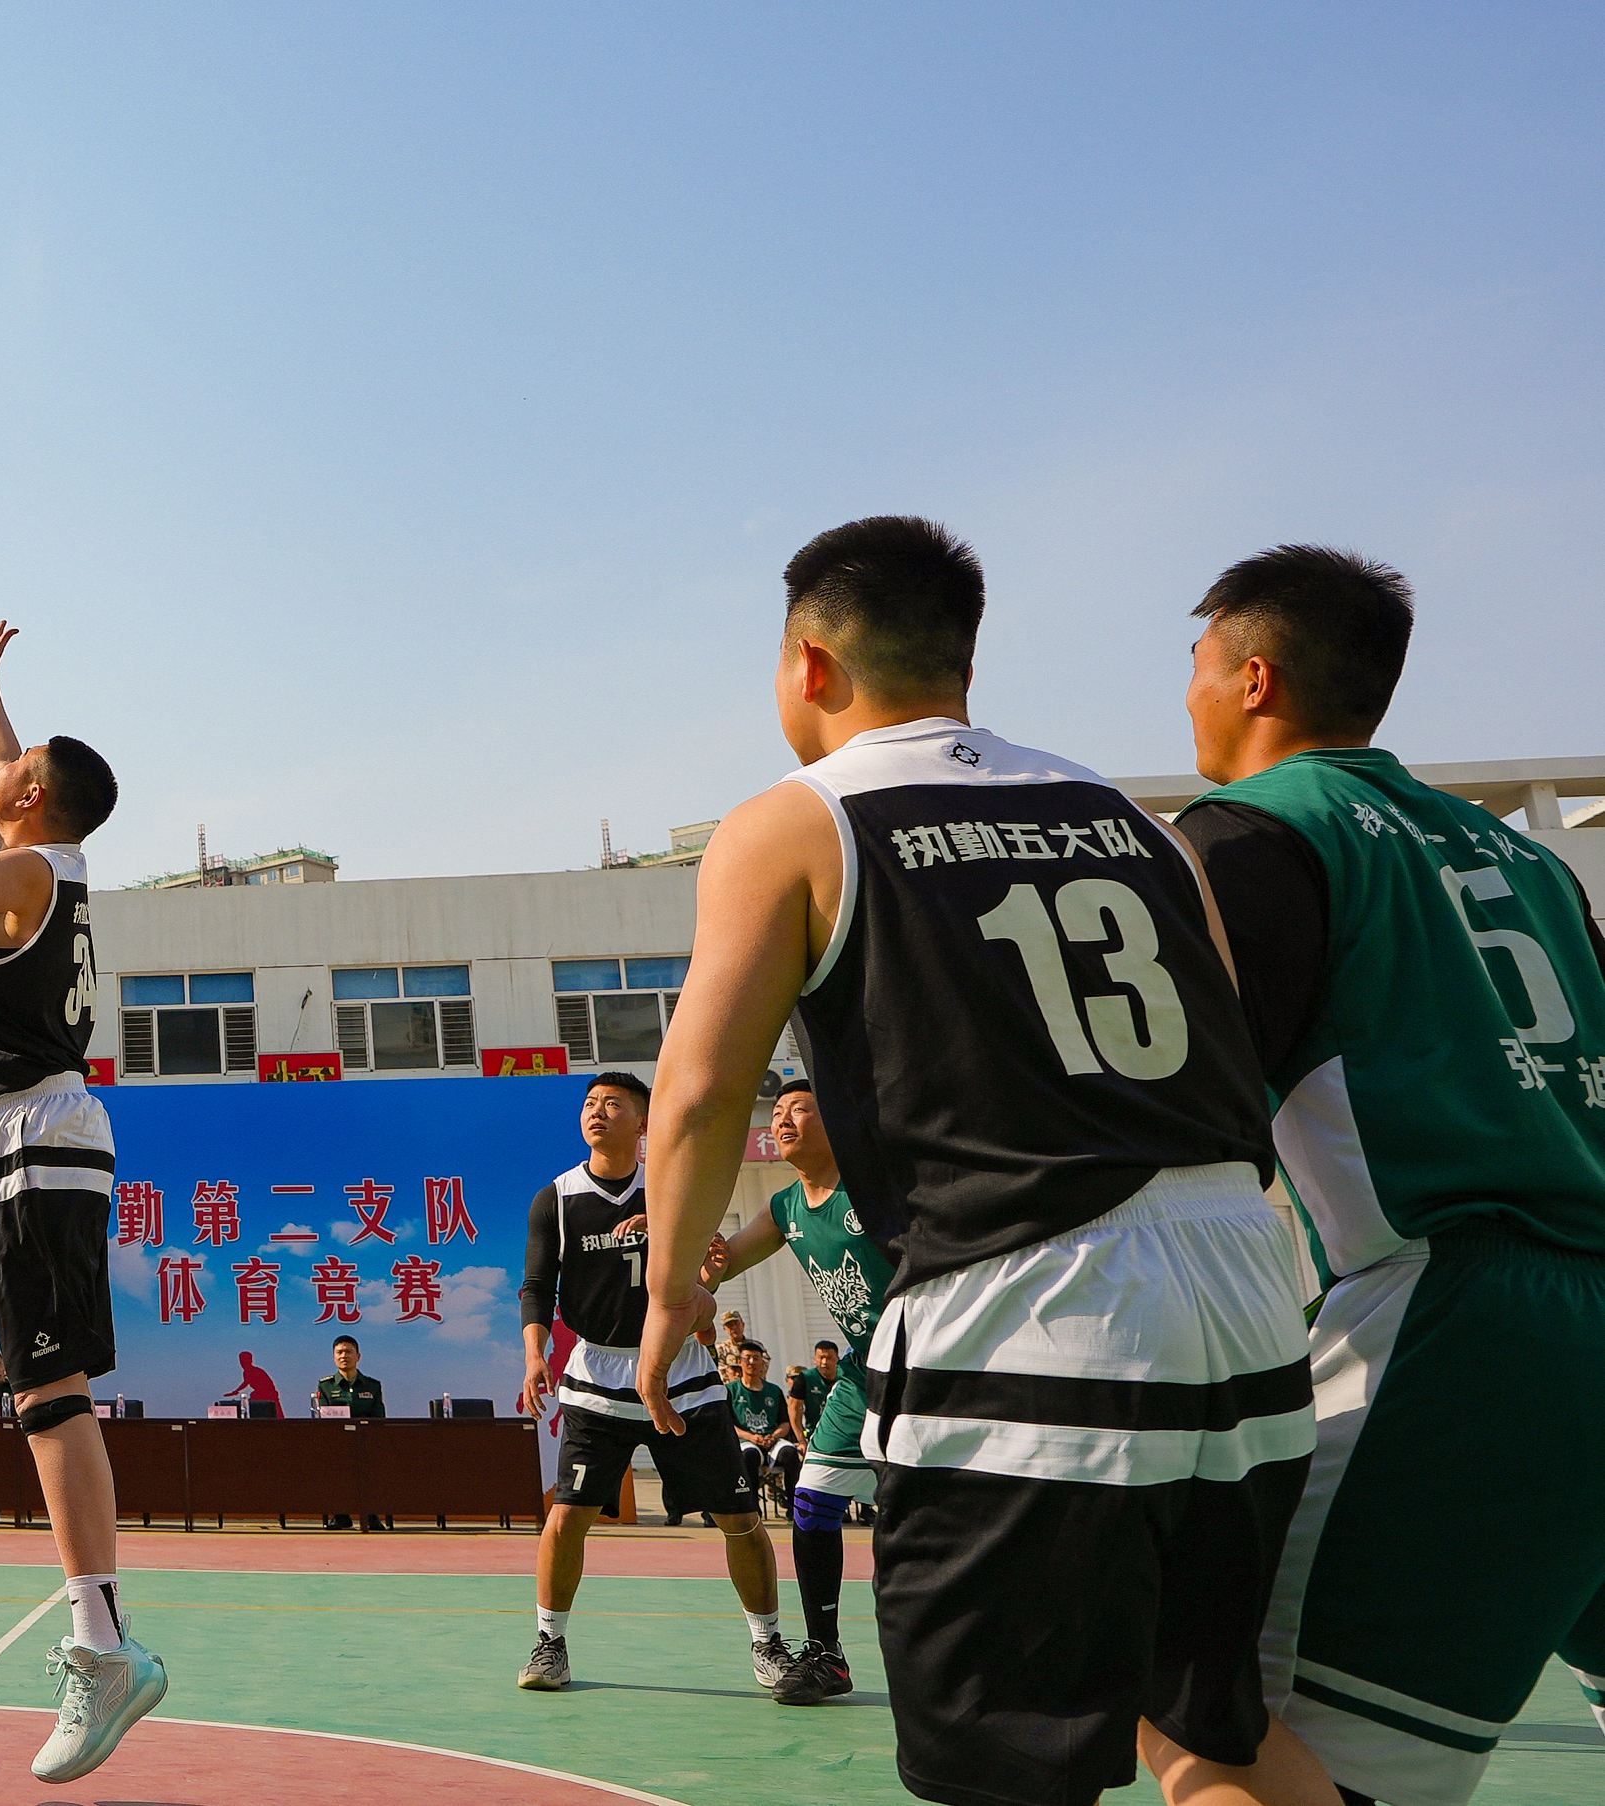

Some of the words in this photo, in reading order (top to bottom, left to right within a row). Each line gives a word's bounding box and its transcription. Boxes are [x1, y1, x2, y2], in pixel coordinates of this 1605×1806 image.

[889, 818, 1154, 870] 执勤五大队
[976, 878, 1189, 1081] 13
[114, 1176, 478, 1248] 勤第二支队
[155, 1254, 445, 1325] 体育竞赛
[622, 1251, 642, 1288] 7
[32, 1342, 61, 1360] RIGORER
[572, 1463, 587, 1491] 7
